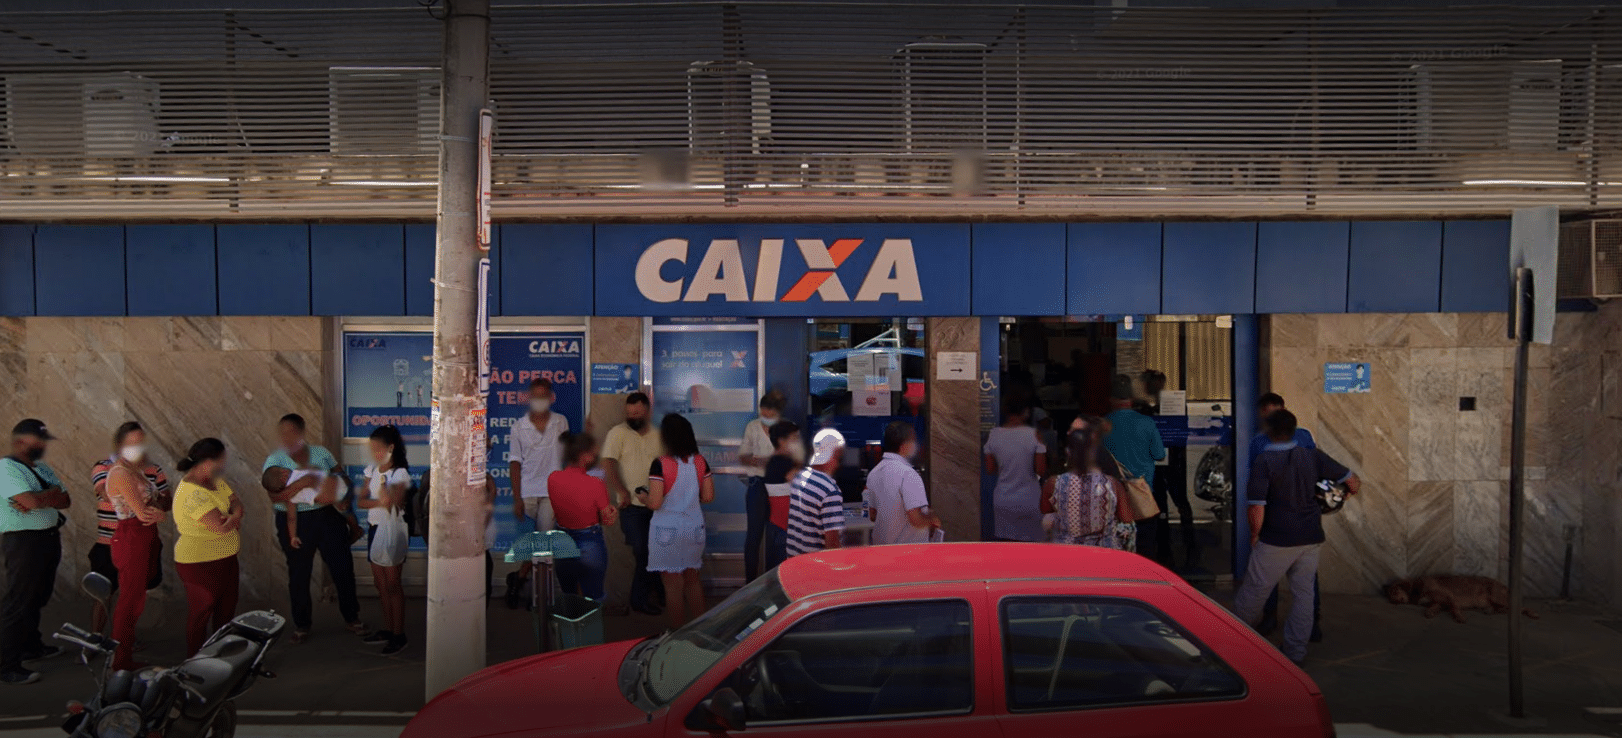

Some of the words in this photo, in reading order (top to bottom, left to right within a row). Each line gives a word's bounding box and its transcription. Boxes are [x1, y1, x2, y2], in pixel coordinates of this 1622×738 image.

[634, 238, 924, 303] CAIXA
[350, 338, 386, 348] CAIXA
[528, 340, 580, 354] CAIXA
[518, 370, 578, 385] PERCA
